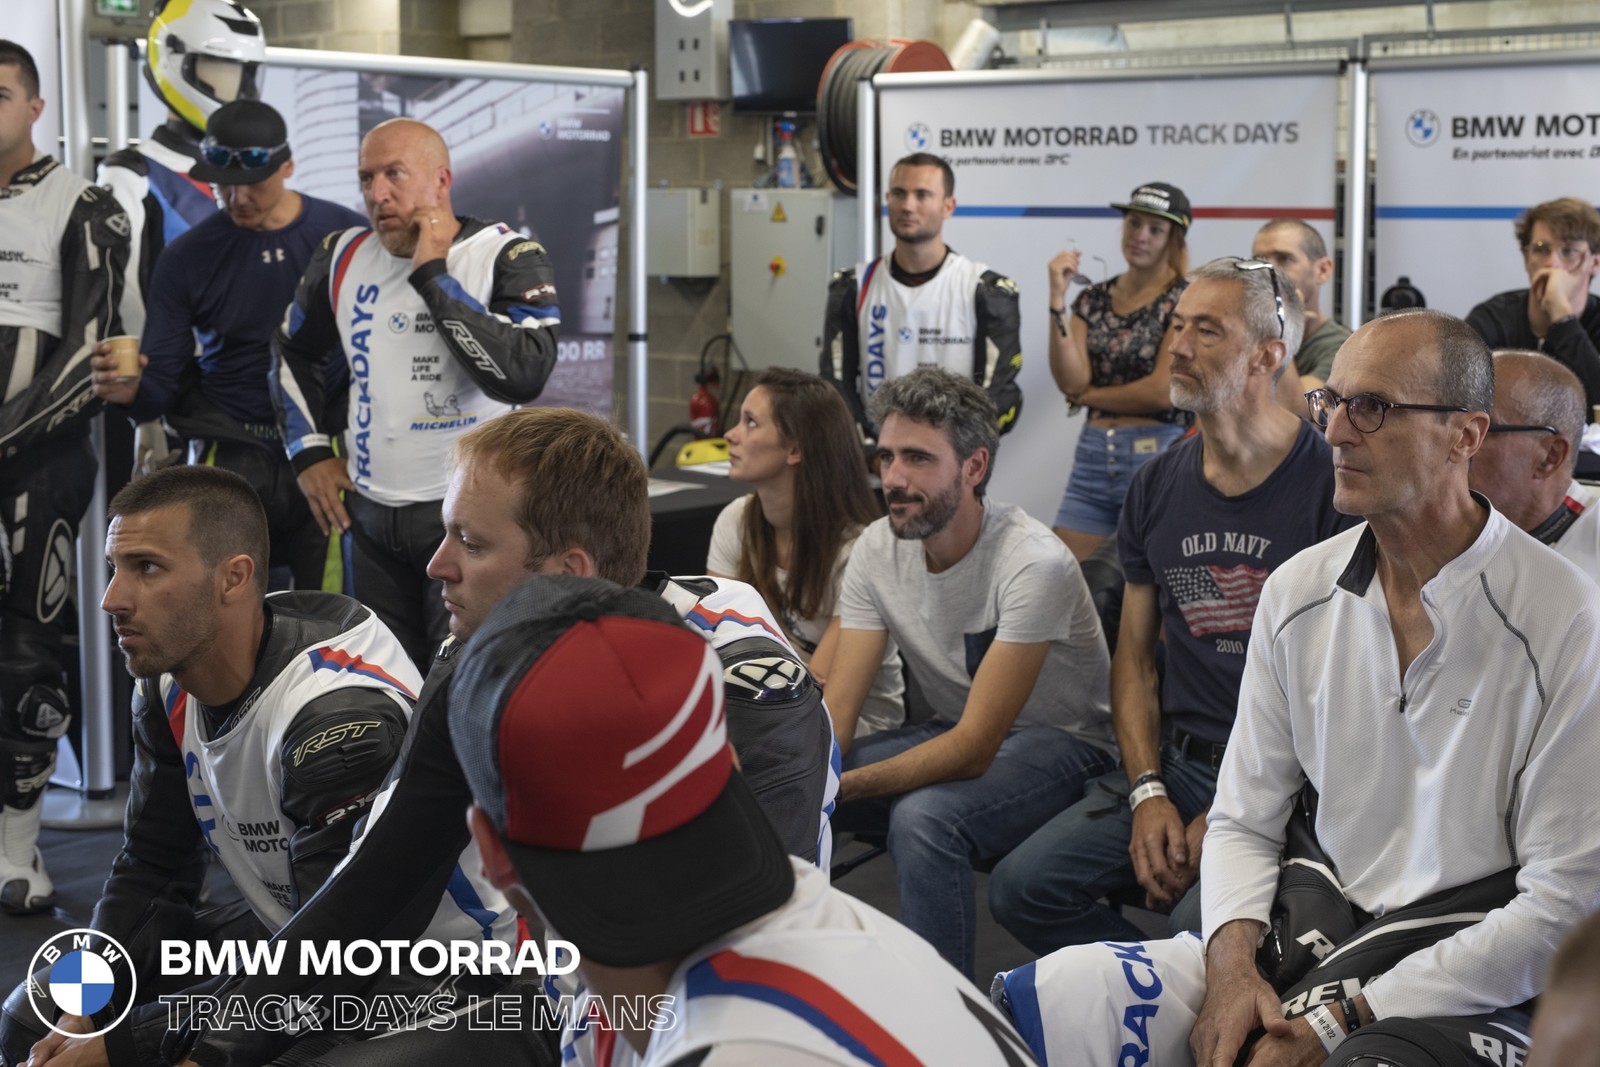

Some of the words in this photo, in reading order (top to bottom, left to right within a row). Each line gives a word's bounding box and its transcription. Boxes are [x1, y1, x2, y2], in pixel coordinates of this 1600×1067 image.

[940, 128, 996, 148] BMW
[1004, 126, 1138, 148] MOTORRAD
[1147, 123, 1229, 146] TRACK
[1234, 122, 1300, 144] DAYS
[1452, 115, 1525, 139] BMW
[1452, 147, 1469, 160] En
[1471, 145, 1550, 162] partenariat
[1552, 148, 1585, 159] avec
[442, 319, 508, 381] RST
[583, 340, 606, 360] RR
[413, 355, 440, 364] MAKE
[412, 364, 432, 373] LIFE
[411, 373, 419, 382] A
[420, 373, 443, 382] RIDE
[410, 415, 478, 432] MICHELIN
[1181, 532, 1217, 558] OLD
[1222, 532, 1272, 560] NAVY
[1216, 638, 1245, 655] 2010
[292, 721, 382, 768] RST
[237, 820, 280, 837] BMW
[263, 879, 292, 895] MAKE
